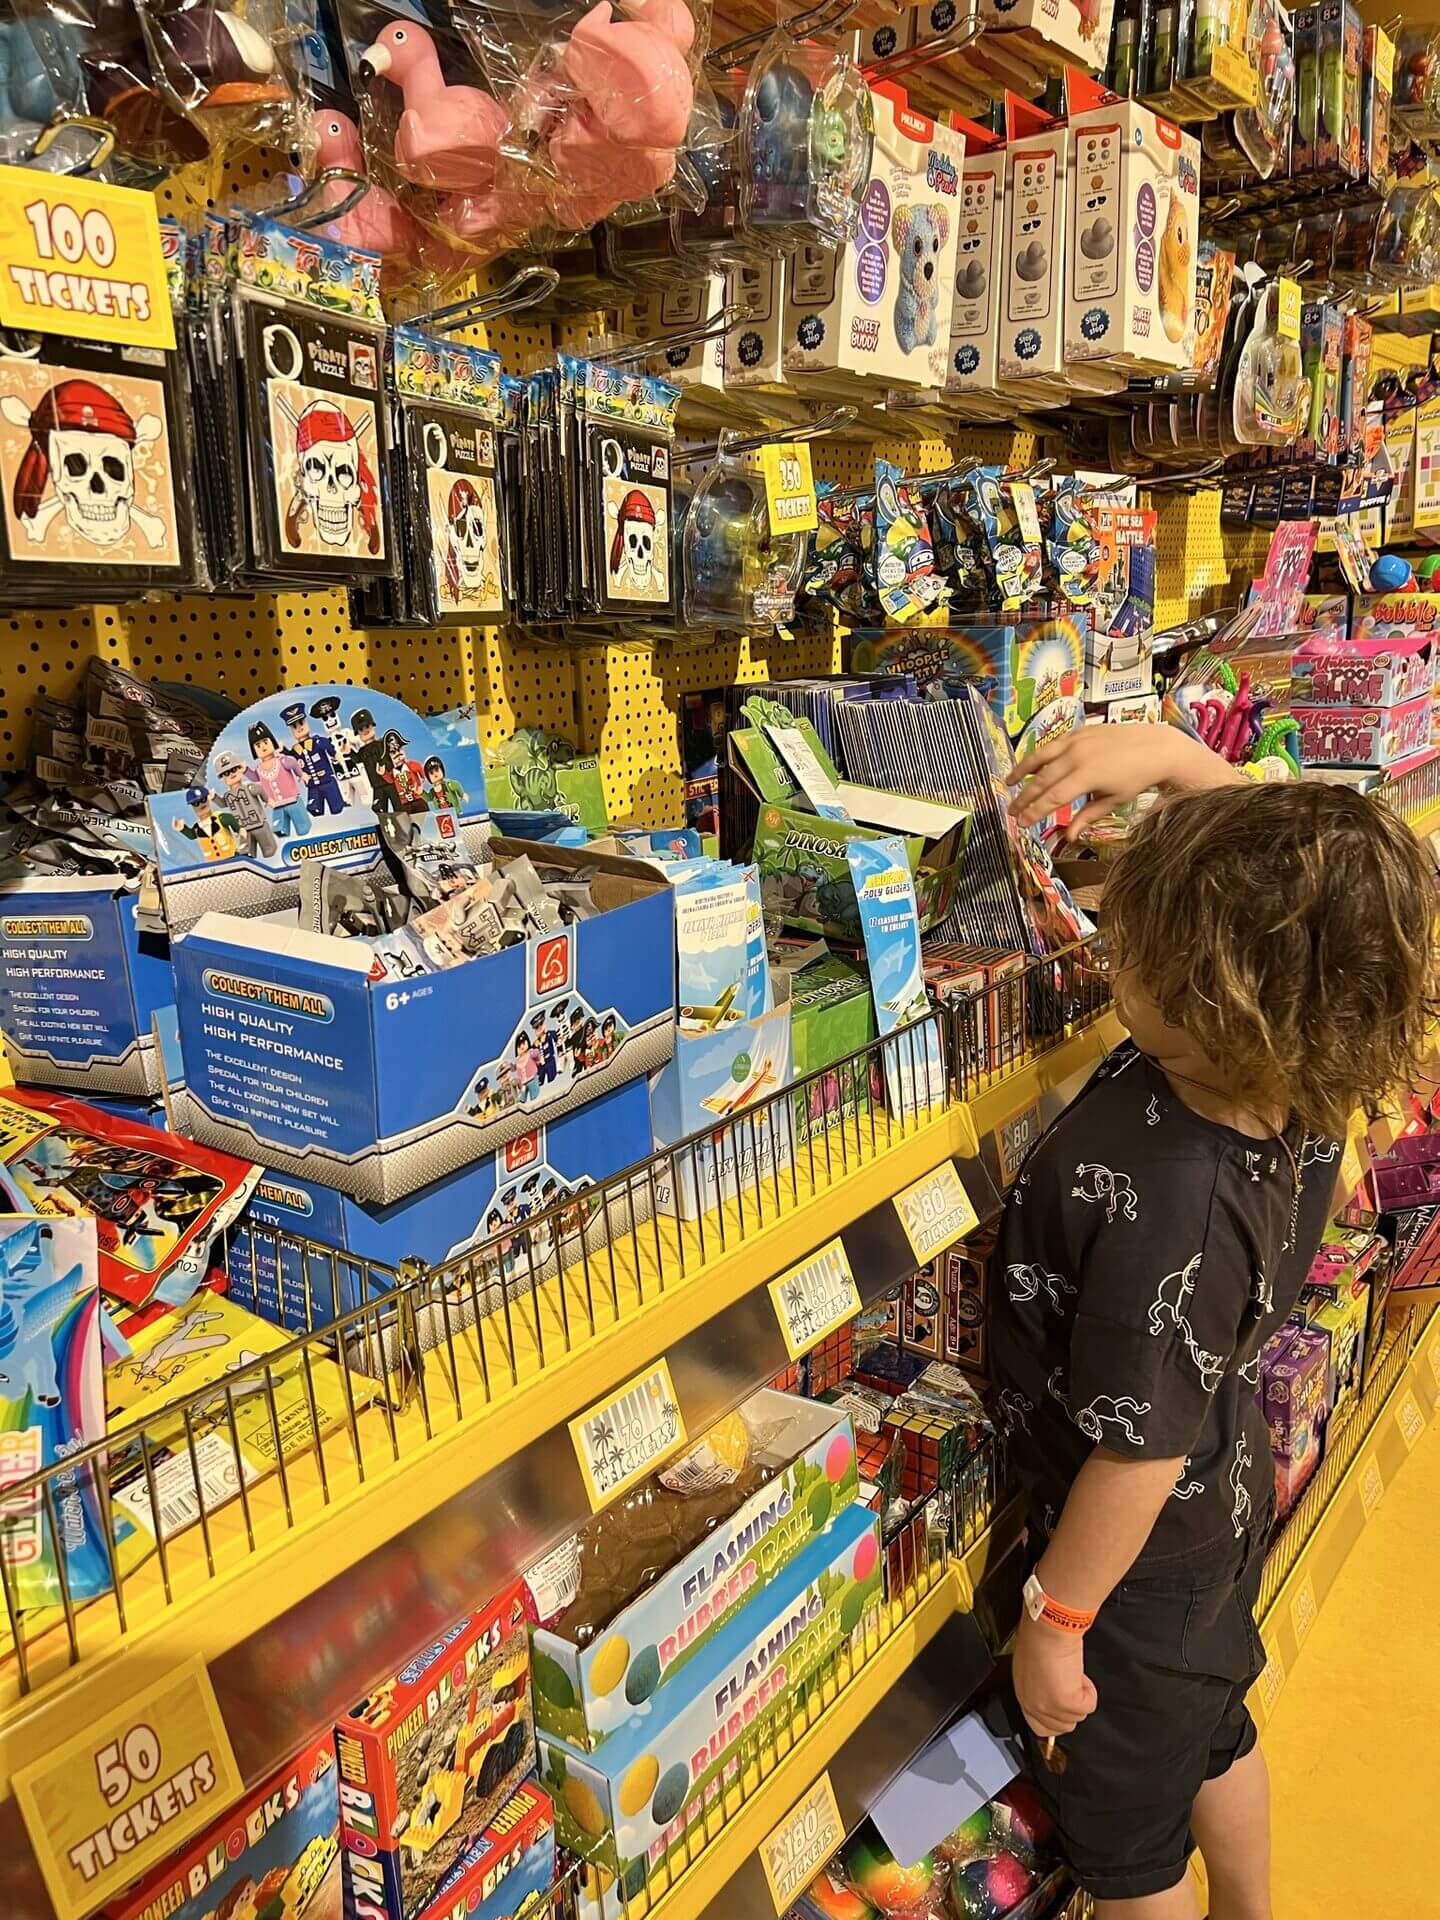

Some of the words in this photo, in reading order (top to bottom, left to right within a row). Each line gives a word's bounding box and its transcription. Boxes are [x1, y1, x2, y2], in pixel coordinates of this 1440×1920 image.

[1297, 16, 1313, 28] 8+
[1323, 8, 1339, 20] 8+
[25, 200, 117, 269] 100
[8, 264, 151, 321] TICKETS
[801, 321, 817, 333] Step
[851, 315, 881, 334] SWEET
[1083, 309, 1101, 325] Step
[1089, 323, 1104, 335] step
[1304, 312, 1320, 324] 8+
[741, 339, 756, 349] Step
[804, 333, 820, 346] step
[851, 331, 880, 352] BUDDY
[1019, 334, 1034, 346] Step
[1023, 343, 1037, 355] step
[307, 340, 348, 368] PIRATE
[744, 349, 759, 360] step
[958, 349, 973, 360] Step
[961, 358, 976, 370] step
[313, 360, 346, 379] PUZZLE
[450, 432, 476, 453] PIRATE
[455, 449, 476, 462] PUZZLE
[627, 447, 651, 466] PIRATE
[630, 461, 649, 474] PUZZLE
[775, 496, 812, 520] TICKETS
[1115, 515, 1130, 528] THE
[1130, 515, 1144, 528] SEA
[1115, 530, 1144, 545] BATTLE
[1374, 600, 1438, 624] Bubble
[885, 648, 949, 675] WHOOPEE
[1330, 668, 1369, 681] POO
[1104, 681, 1124, 694] PUZZLE
[1124, 679, 1143, 691] GAMES
[1313, 674, 1384, 704] SLIME
[1320, 726, 1358, 738] POO
[1303, 732, 1373, 761] SLIME
[82, 815, 112, 831] THEM
[290, 840, 344, 862] COLLECT
[345, 833, 377, 851] THEM
[785, 830, 849, 860] DINOSA
[863, 888, 884, 899] POLY
[885, 883, 911, 896] GLIDERS
[6, 919, 44, 936] COLLECT
[43, 919, 68, 936] THEM
[68, 919, 88, 936] ALL
[3, 949, 26, 960] HIGH
[28, 949, 68, 961] QUALITY
[6, 967, 30, 978] HIGH
[31, 968, 106, 981] PERFORMANCE
[9, 990, 23, 1000] THE
[210, 975, 262, 1000] COLLECT
[265, 987, 300, 1010] THEM
[302, 996, 327, 1017] ALL
[385, 990, 411, 1012] 6+
[411, 985, 434, 999] AGES
[15, 1018, 29, 1027] THE
[28, 1019, 41, 1028] ALL
[51, 1007, 68, 1016] YOUR
[201, 1002, 236, 1021] HIGH
[238, 1012, 295, 1037] QUALITY
[203, 1023, 238, 1042] HIGH
[240, 1033, 344, 1071] PERFORMANCE
[205, 1048, 223, 1061] THE
[223, 1054, 268, 1075] EXCELLENT
[270, 1067, 303, 1085] DESIGN
[207, 1064, 242, 1083] SPECIAL
[242, 1075, 260, 1088] FOR
[260, 1080, 284, 1095] YOUR
[285, 1088, 329, 1107] CHILDREN
[208, 1079, 226, 1092] THE
[226, 1085, 243, 1097] ALL
[243, 1090, 280, 1110] EXCITING
[280, 1100, 301, 1115] NEW
[301, 1106, 318, 1120] SET
[318, 1112, 341, 1127] WILL
[210, 1094, 231, 1108] GIVE
[231, 1102, 250, 1115] YOU
[249, 1107, 283, 1125] INFINITE
[283, 1118, 328, 1139] PLEASURE
[1013, 1118, 1030, 1149] 80
[254, 1184, 284, 1204] THEM
[285, 1190, 306, 1210] ALL
[920, 1186, 946, 1224] 80
[918, 1205, 969, 1252] TICKETS
[949, 1261, 958, 1293] Puzzle
[810, 1284, 827, 1310] 60
[619, 1417, 643, 1447] 70
[600, 1420, 674, 1489] TICKETS
[681, 1487, 793, 1610] FLASHING
[656, 1558, 759, 1669] RUBBER
[759, 1506, 815, 1576] BALL
[713, 1592, 824, 1718] FLASHING
[386, 1700, 425, 1761] PIONEER
[425, 1617, 502, 1722] BLOCKS
[688, 1663, 789, 1780] RUBBER
[788, 1608, 842, 1685] BALL
[94, 1723, 161, 1809] 50
[339, 1733, 368, 1786] PIONEER
[68, 1751, 217, 1883] TICKETS
[489, 1790, 539, 1836] PIONEER
[187, 1775, 302, 1898] BLOCKS
[782, 1807, 819, 1863] 180
[341, 1782, 389, 1920] BLOCKS
[781, 1825, 834, 1895] TICKETS
